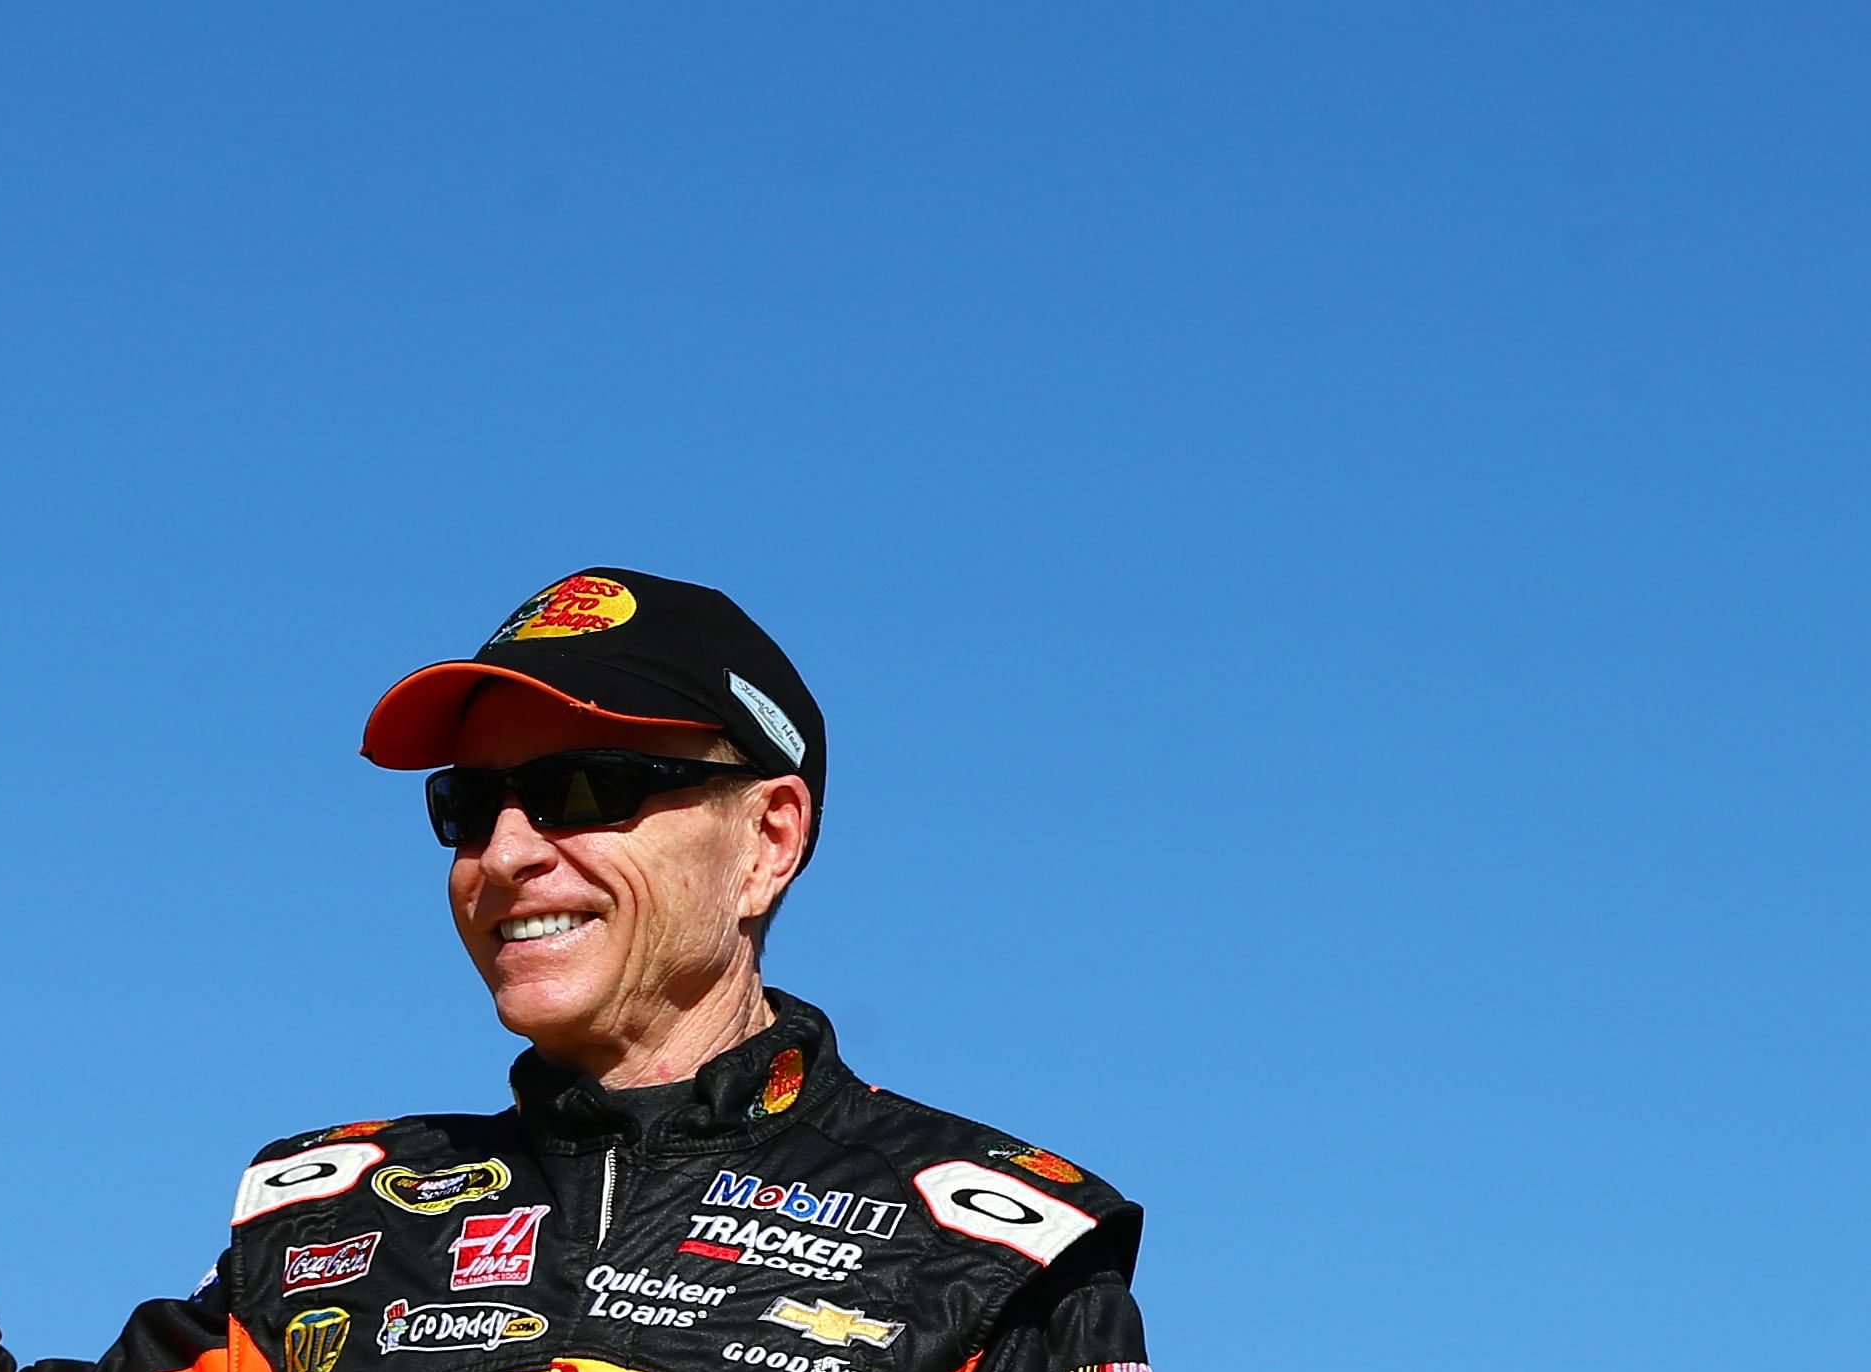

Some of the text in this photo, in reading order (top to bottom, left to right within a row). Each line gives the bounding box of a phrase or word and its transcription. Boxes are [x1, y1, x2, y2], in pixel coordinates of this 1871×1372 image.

[702, 1170, 889, 1232] Mobil 1
[687, 1214, 863, 1269] TRACKER
[736, 1247, 849, 1281] boats
[585, 1265, 727, 1306] Quicken
[588, 1292, 697, 1327] Loans
